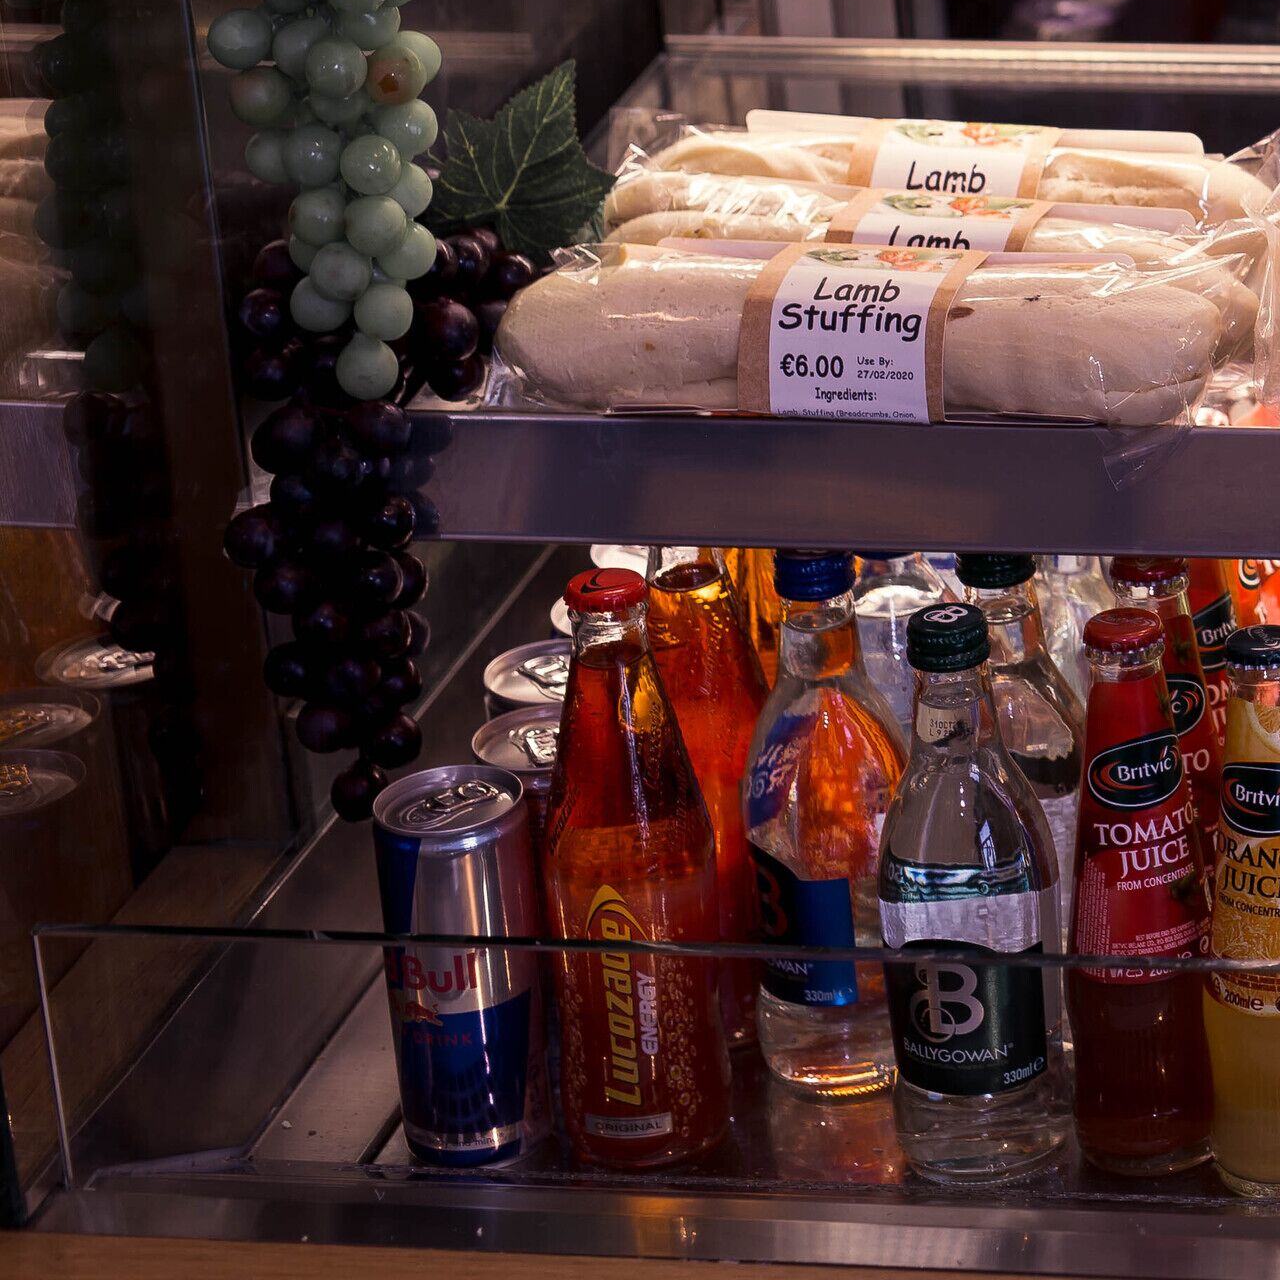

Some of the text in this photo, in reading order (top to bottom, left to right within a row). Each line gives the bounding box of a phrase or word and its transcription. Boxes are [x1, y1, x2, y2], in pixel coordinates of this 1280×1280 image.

[906, 161, 986, 193] Lamb
[813, 276, 901, 303] Lamb
[777, 303, 922, 342] Stuffing
[779, 353, 844, 379] €6.00
[857, 370, 914, 381] 27/02/2020
[815, 387, 878, 403] Ingredients:
[1093, 802, 1194, 847] TOMATO
[1119, 838, 1189, 878] JUICE
[1116, 878, 1142, 892] FROM
[404, 954, 477, 991] Bull
[805, 989, 833, 1001] 330ml
[414, 1032, 473, 1046] DRINK
[903, 1036, 1008, 1064] BALLYGOWAN
[1003, 1065, 1031, 1084] 330ml
[594, 1120, 663, 1134] ORIGINAL
